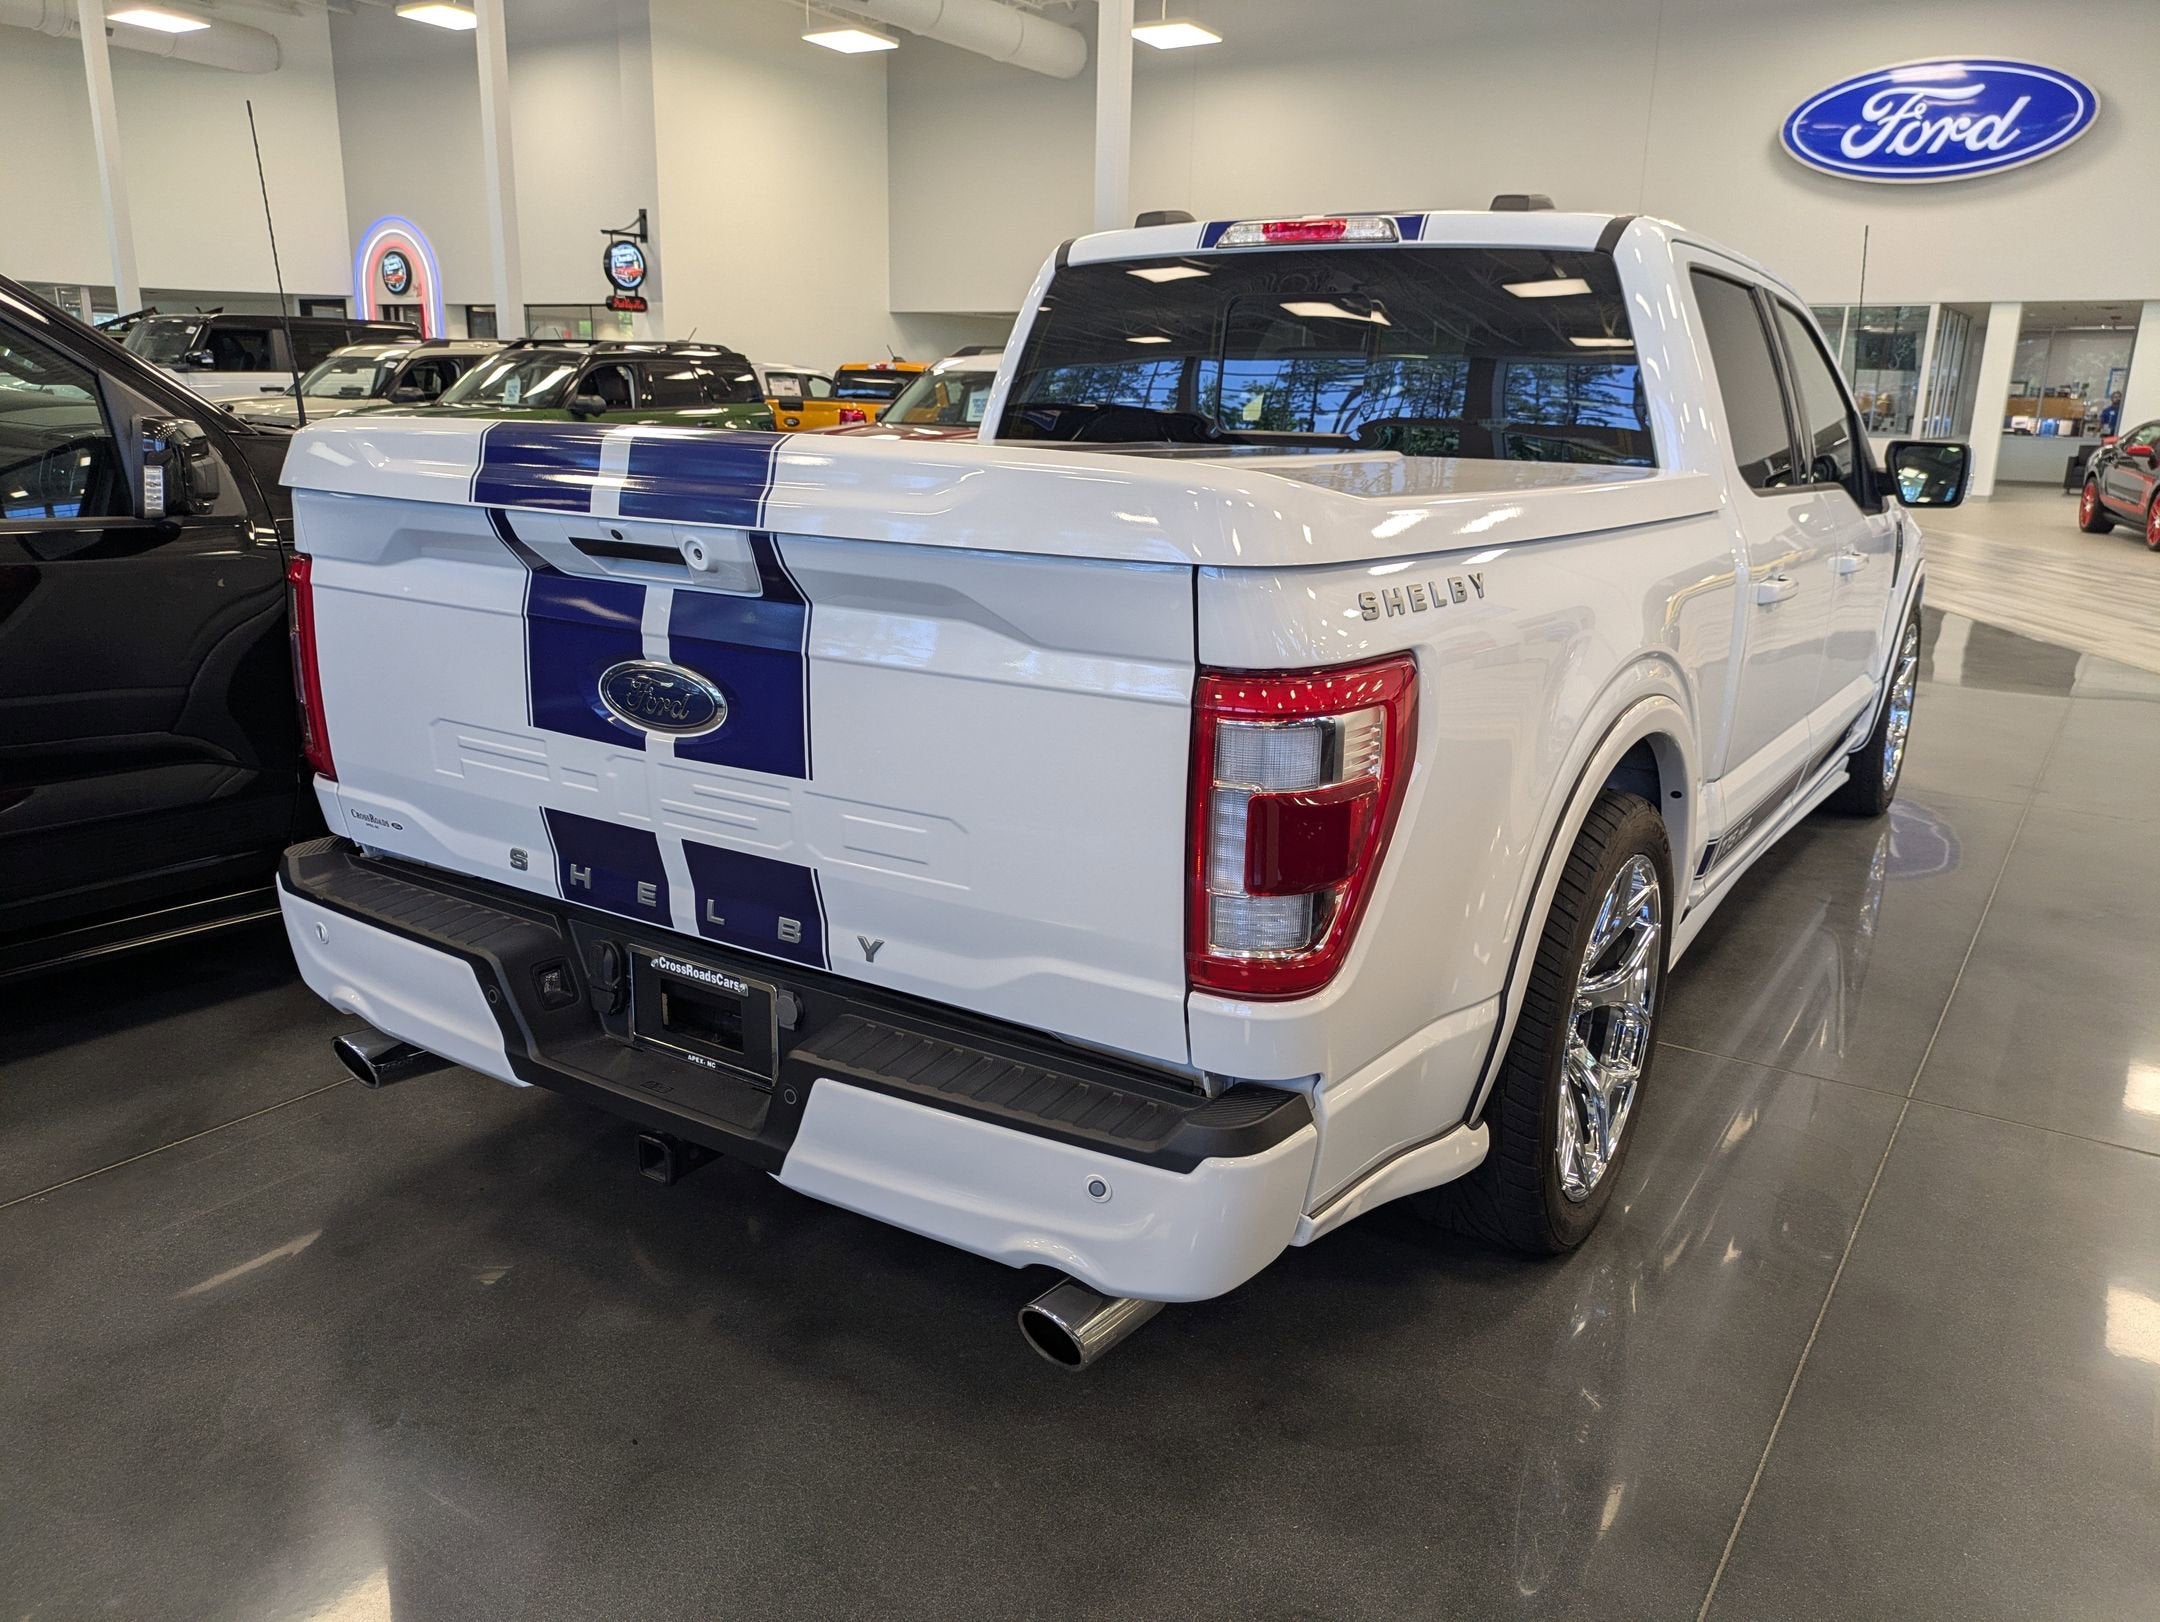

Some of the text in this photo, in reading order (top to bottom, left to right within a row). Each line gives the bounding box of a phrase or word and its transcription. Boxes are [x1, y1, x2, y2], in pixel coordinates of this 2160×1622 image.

[1840, 83, 2032, 159] Ford
[1358, 572, 1485, 621] SHELBY
[626, 673, 693, 720] Ford
[508, 847, 885, 963] SHELBY
[658, 956, 741, 992] CrossRoadsCars
[706, 1060, 717, 1069] NC
